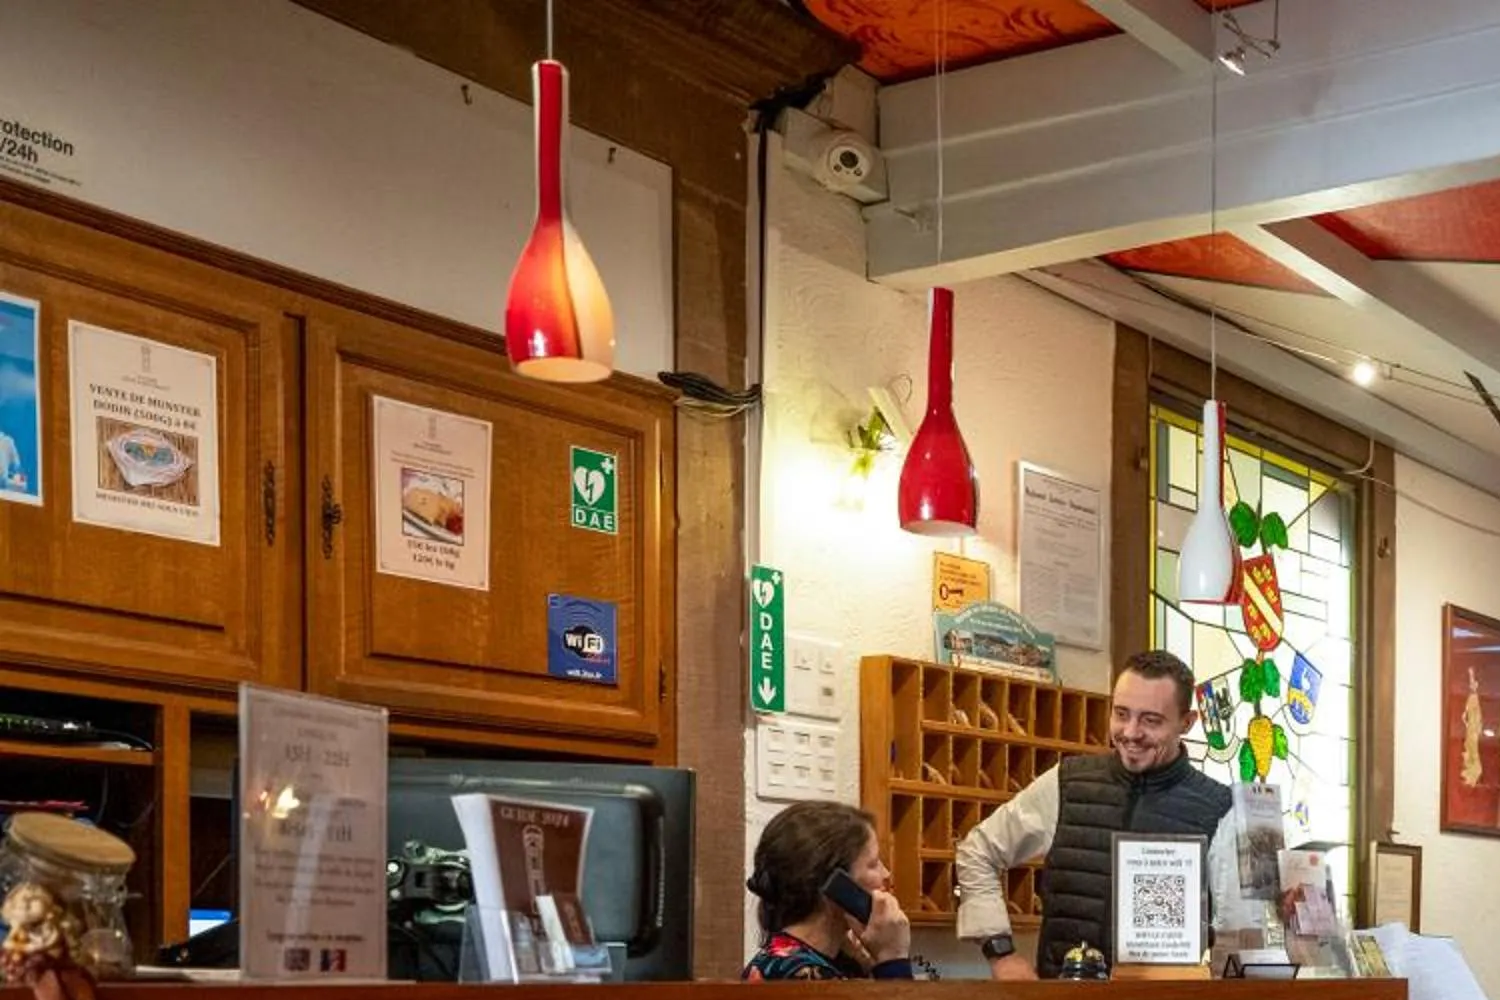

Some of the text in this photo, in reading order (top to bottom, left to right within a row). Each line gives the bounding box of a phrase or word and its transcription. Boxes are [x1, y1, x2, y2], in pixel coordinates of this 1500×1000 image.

[0, 119, 74, 157] otection
[89, 382, 127, 400] VENTE
[130, 391, 145, 405] DE
[148, 397, 200, 418] MUNSTER
[575, 509, 613, 530] DAE
[760, 612, 773, 670] DAE
